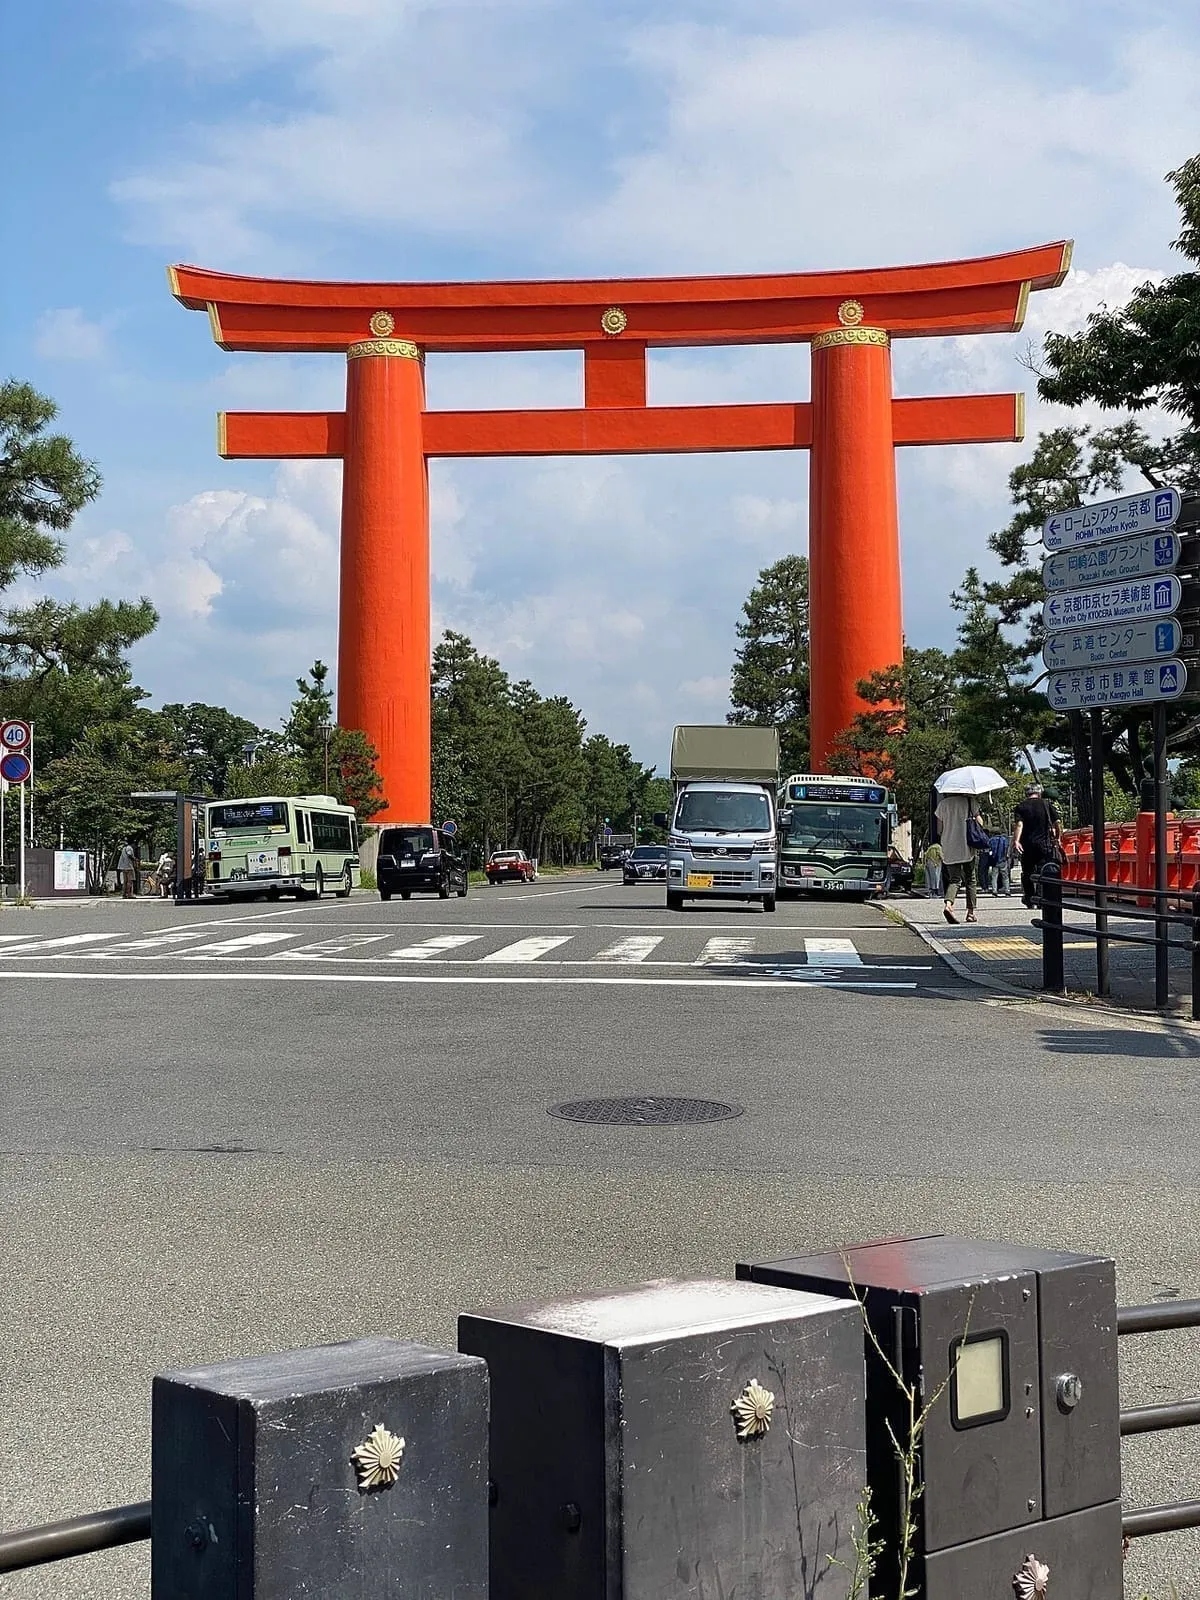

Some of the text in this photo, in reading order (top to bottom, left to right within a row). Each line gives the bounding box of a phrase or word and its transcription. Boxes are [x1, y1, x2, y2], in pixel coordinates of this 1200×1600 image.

[1064, 499, 1151, 532] ロームシアター京都
[1075, 529, 1094, 541] ROHM
[1096, 525, 1119, 537] Theatre
[1120, 520, 1139, 533] Kyoto
[1068, 541, 1149, 571] 岡崎公園グランド
[1078, 570, 1100, 582] Okazaki
[1102, 567, 1117, 578] Koen
[1119, 564, 1140, 575] Ground
[1063, 584, 1151, 613] 京都市京セラ美術館
[1062, 614, 1076, 625] Kyoto
[1077, 613, 1088, 623] City
[1088, 609, 1113, 621] KYOCERA
[1114, 606, 1136, 616] Museum
[1136, 605, 1143, 613] of
[1143, 603, 1152, 612] Art
[1072, 628, 1147, 651] 武道センター
[1090, 652, 1105, 661] Budo
[1109, 649, 1128, 659] Center
[1070, 669, 1155, 693] 京都市勧業館
[1080, 694, 1096, 703] Kyoto
[1097, 692, 1108, 702] City
[1109, 690, 1130, 700] Kangyo
[1132, 687, 1144, 697] Hall
[6, 728, 24, 742] 40
